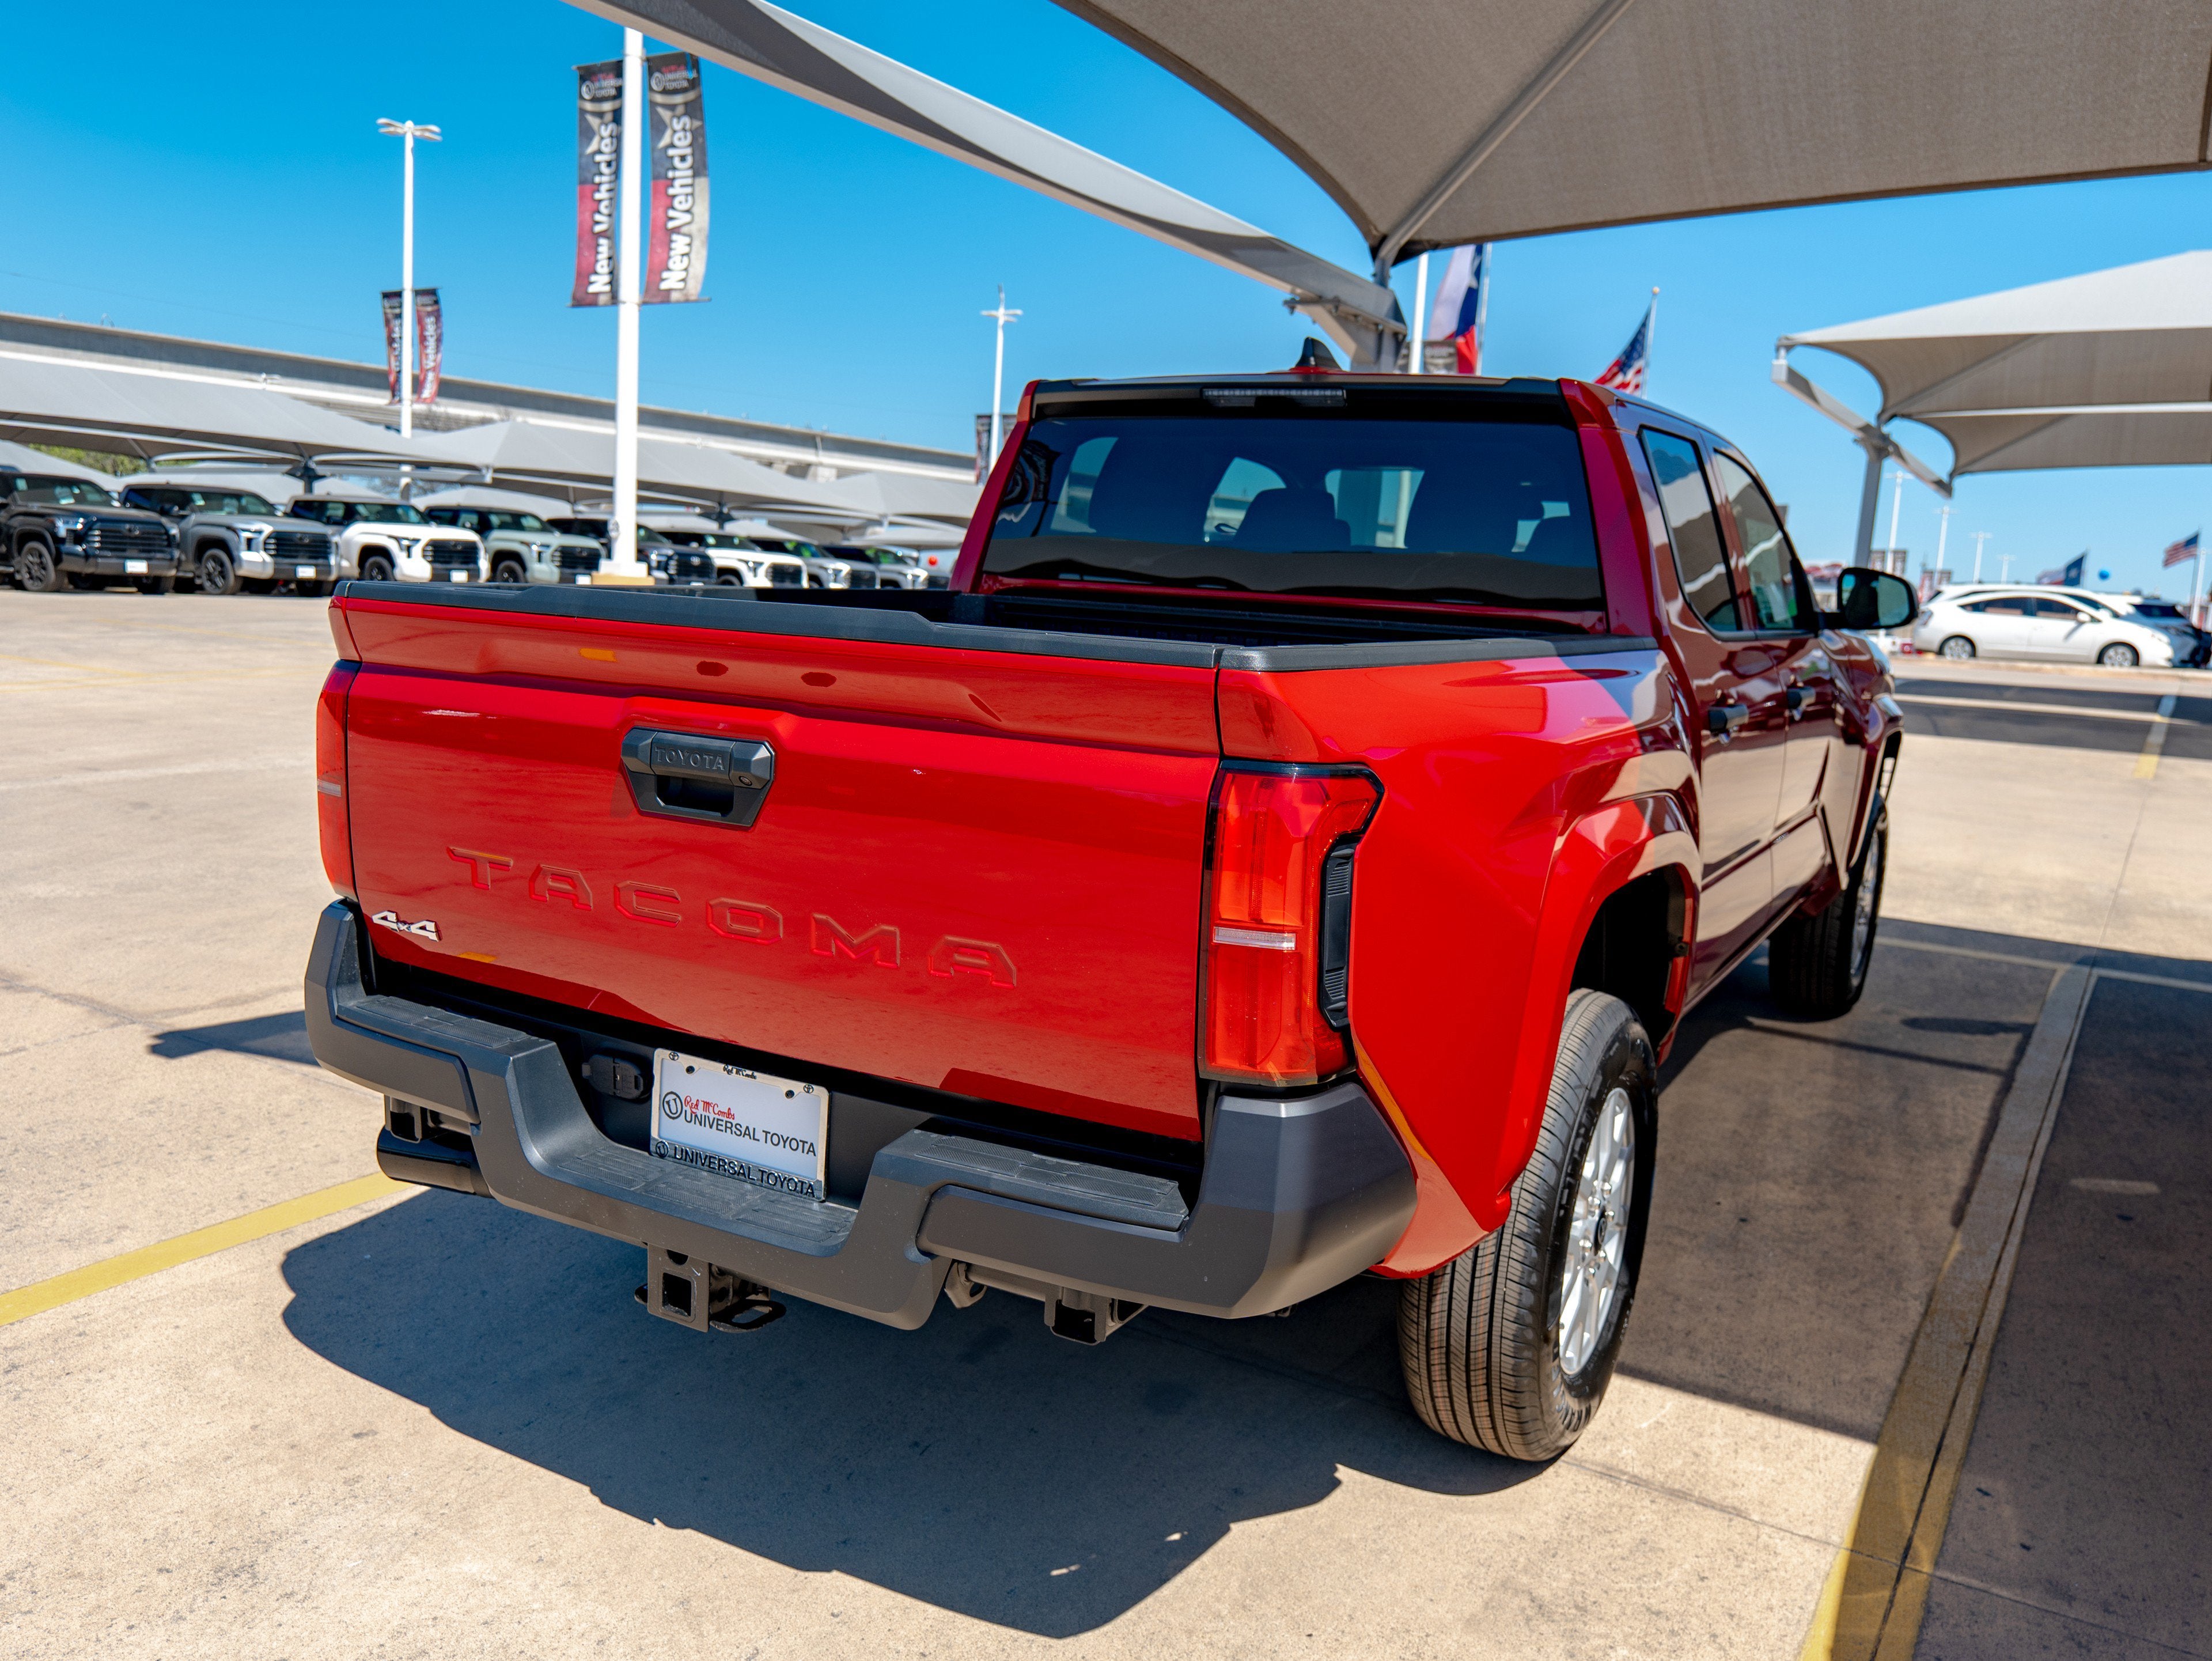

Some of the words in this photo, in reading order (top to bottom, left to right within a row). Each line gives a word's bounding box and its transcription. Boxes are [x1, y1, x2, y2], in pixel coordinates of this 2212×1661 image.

[593, 122, 618, 233] Vehicles
[666, 115, 693, 230] Vehicles
[587, 237, 612, 293] New
[659, 233, 691, 290] New
[655, 746, 725, 770] TOYOTA
[447, 846, 1017, 988] TACOMA
[684, 1095, 699, 1114] Red
[700, 1099, 734, 1120] McCombs
[684, 1110, 759, 1142] UNIVERSAL
[762, 1130, 816, 1156] TOYOTA
[674, 1145, 756, 1181] UNIVERSAL
[758, 1168, 816, 1198] TOYOTA
